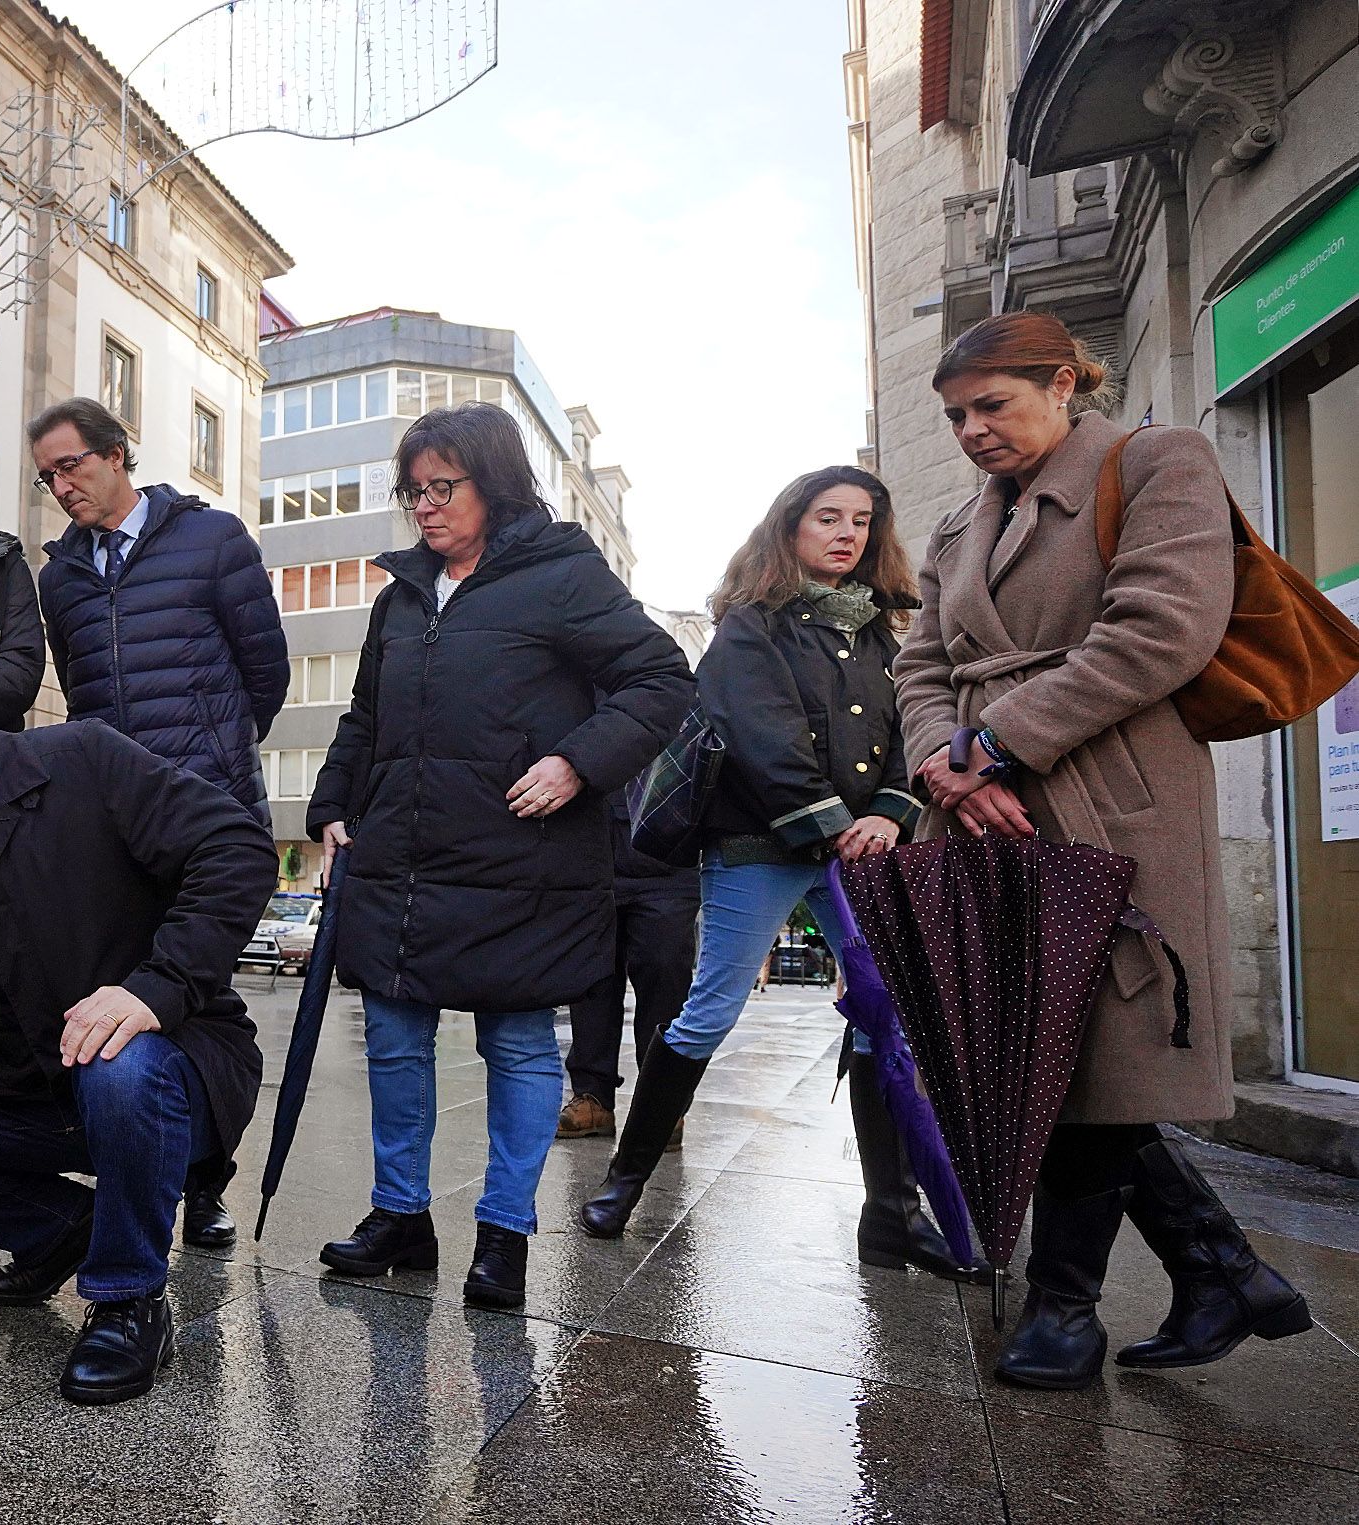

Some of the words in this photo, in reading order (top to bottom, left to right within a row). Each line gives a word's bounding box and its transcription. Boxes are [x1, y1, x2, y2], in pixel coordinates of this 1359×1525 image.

[1256, 285, 1284, 313] Punto
[1285, 273, 1298, 290] de
[1299, 236, 1345, 279] atención
[1257, 299, 1297, 334] Clientes
[1328, 744, 1349, 759] Plan
[1329, 763, 1350, 779] para
